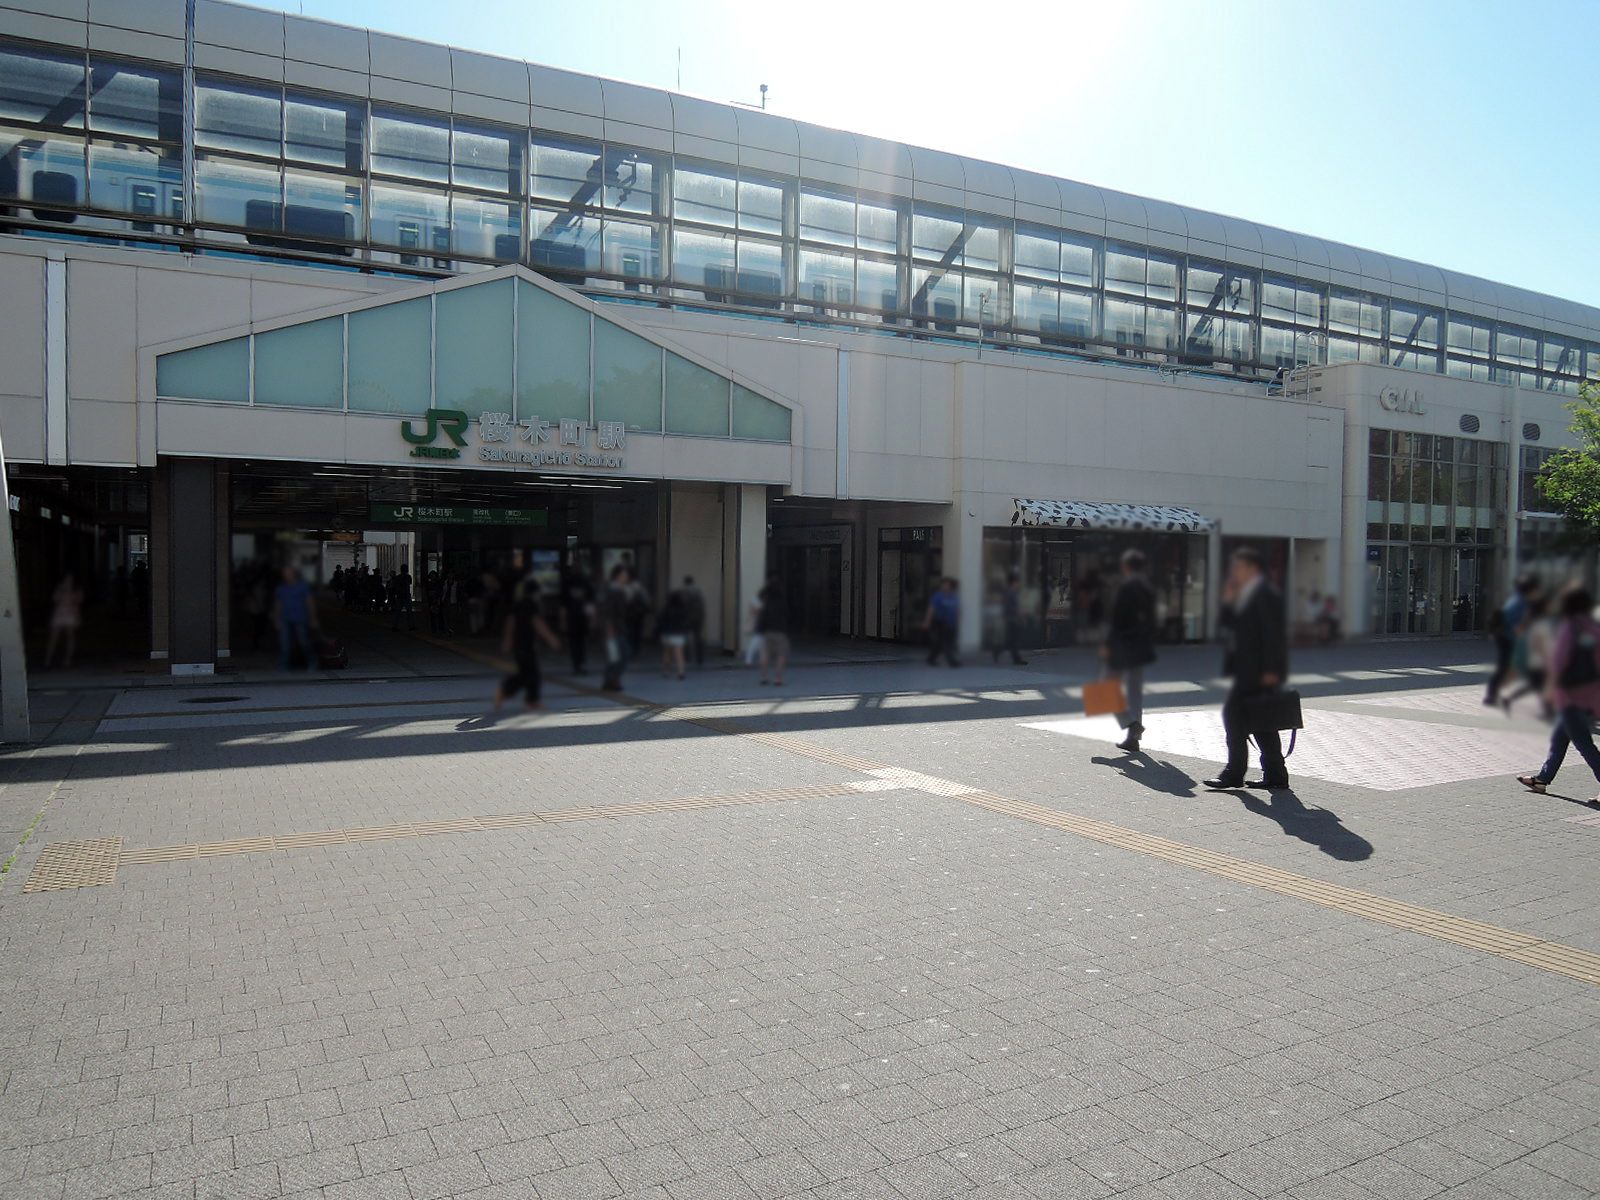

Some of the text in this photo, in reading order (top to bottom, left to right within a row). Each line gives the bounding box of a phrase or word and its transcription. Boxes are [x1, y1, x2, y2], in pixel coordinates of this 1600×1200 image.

[402, 408, 468, 446] JR
[479, 411, 625, 450] 桜木町駅
[574, 450, 624, 468] Station
[393, 507, 414, 518] JR
